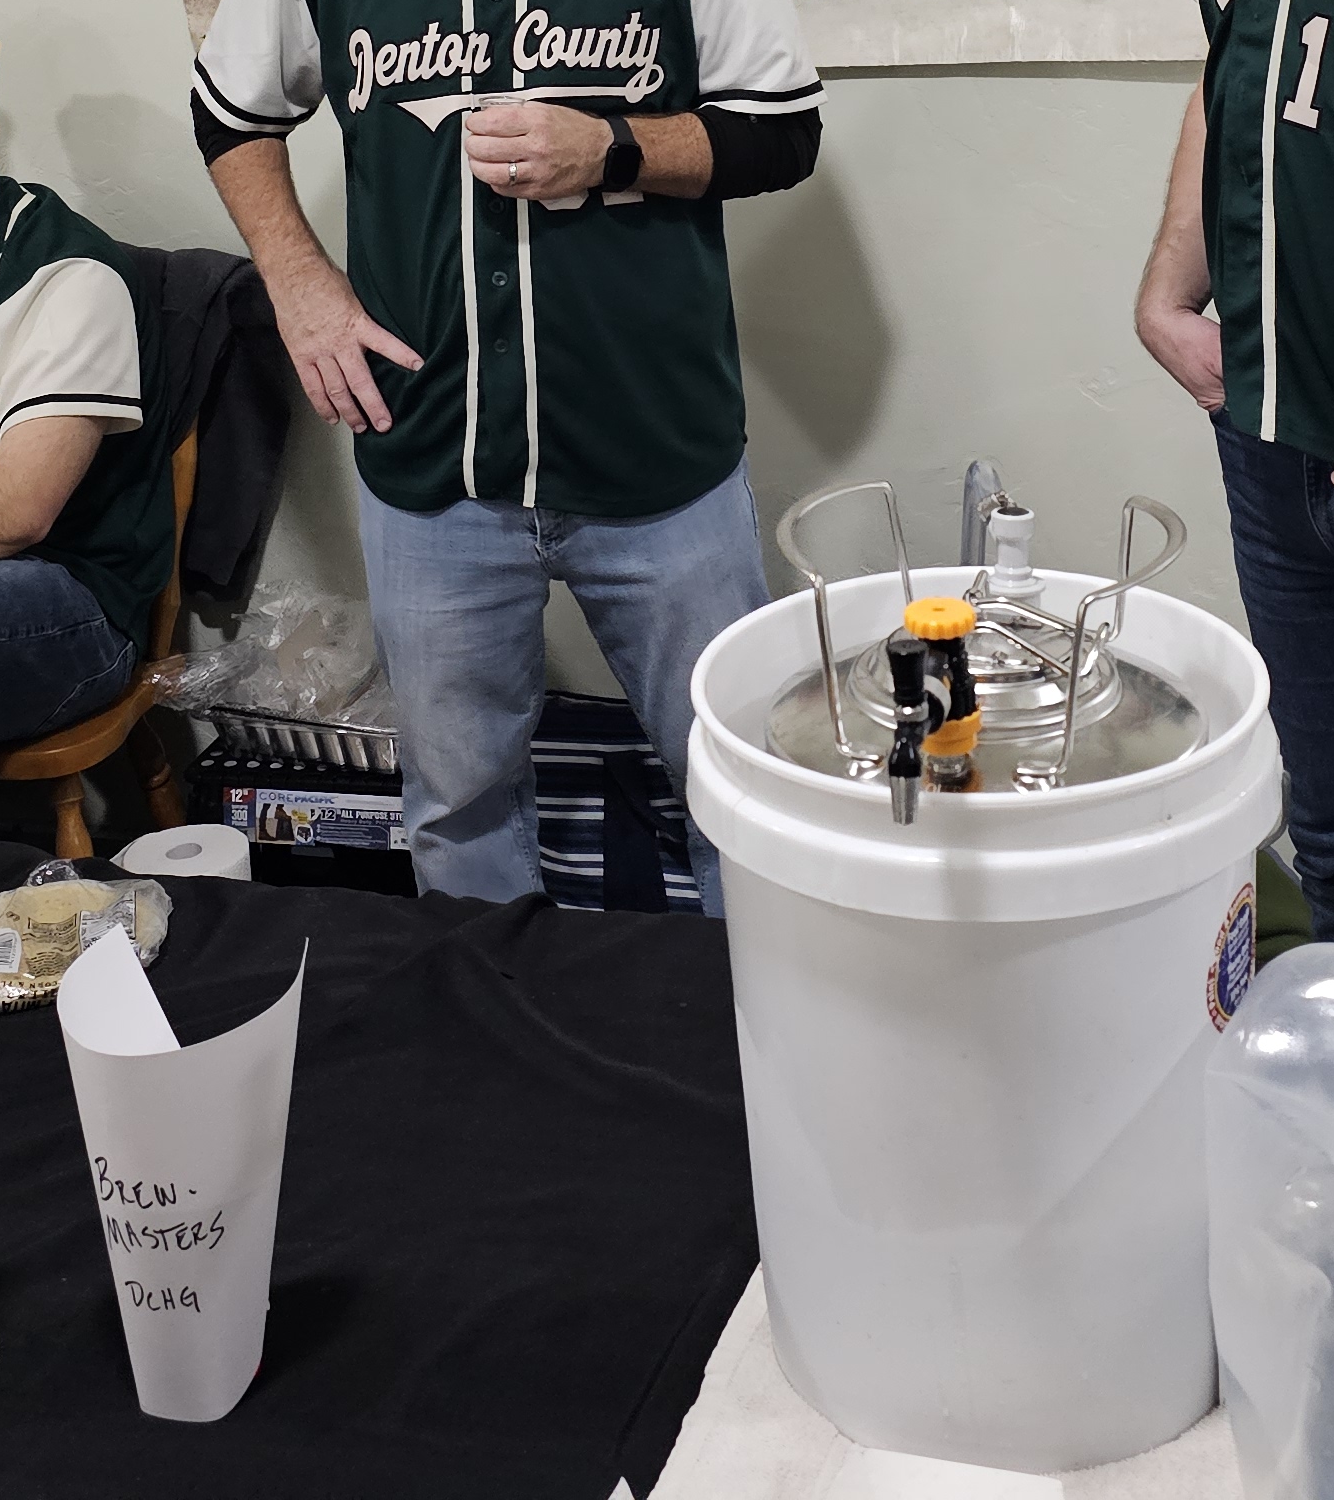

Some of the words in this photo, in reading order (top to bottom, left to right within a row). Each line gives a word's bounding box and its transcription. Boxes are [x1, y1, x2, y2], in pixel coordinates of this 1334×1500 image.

[348, 21, 491, 114] Denton
[513, 9, 665, 104] County
[106, 1210, 225, 1253] MASTERS
[125, 1280, 201, 1313] DCHG
